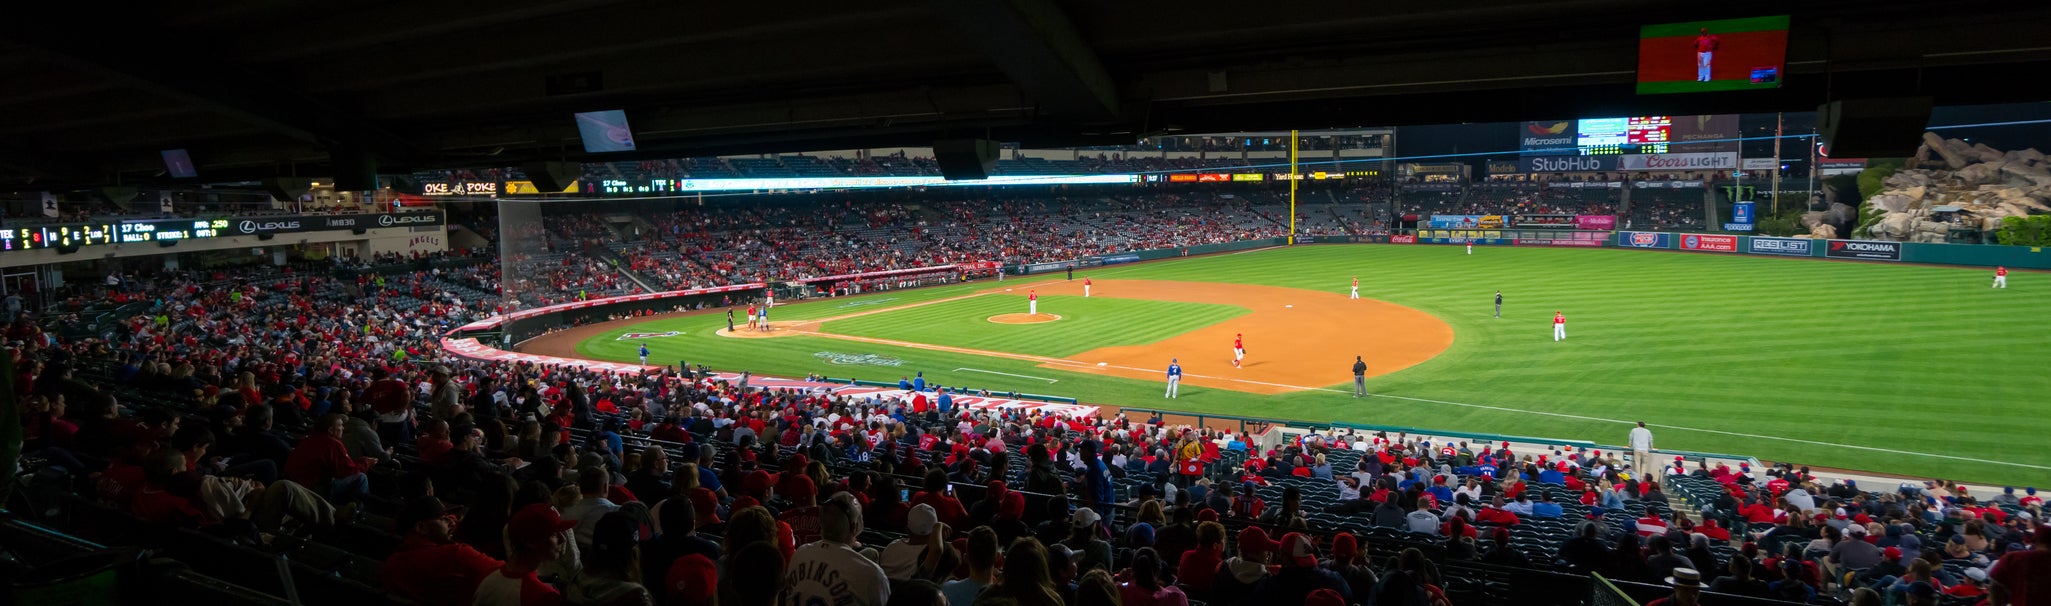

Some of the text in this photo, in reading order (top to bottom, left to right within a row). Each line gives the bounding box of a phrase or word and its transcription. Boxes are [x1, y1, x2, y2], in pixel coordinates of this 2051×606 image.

[1524, 135, 1573, 146] Microsemi
[1532, 157, 1601, 172] StubHub
[1645, 154, 1729, 168] Coors LIGHT
[1488, 164, 1516, 173] Modelo
[425, 182, 496, 193] OKE POKE
[392, 214, 436, 223] LEXUS
[102, 224, 109, 234] 7
[122, 224, 133, 233] 17
[134, 223, 155, 232] Choo
[211, 220, 228, 228] .250
[257, 220, 301, 231] LEXUS
[21, 229, 29, 238] 5
[49, 226, 68, 242] H 9
[73, 226, 90, 241] E 2
[23, 239, 31, 249] 1
[63, 236, 70, 246] 4
[85, 236, 92, 246] 1
[104, 234, 111, 244] 7
[408, 234, 440, 248] ANGELS
[1700, 243, 1732, 251] AAA.com
[1753, 241, 1808, 250] RES LIST
[1845, 243, 1895, 252] YOKOHAMA
